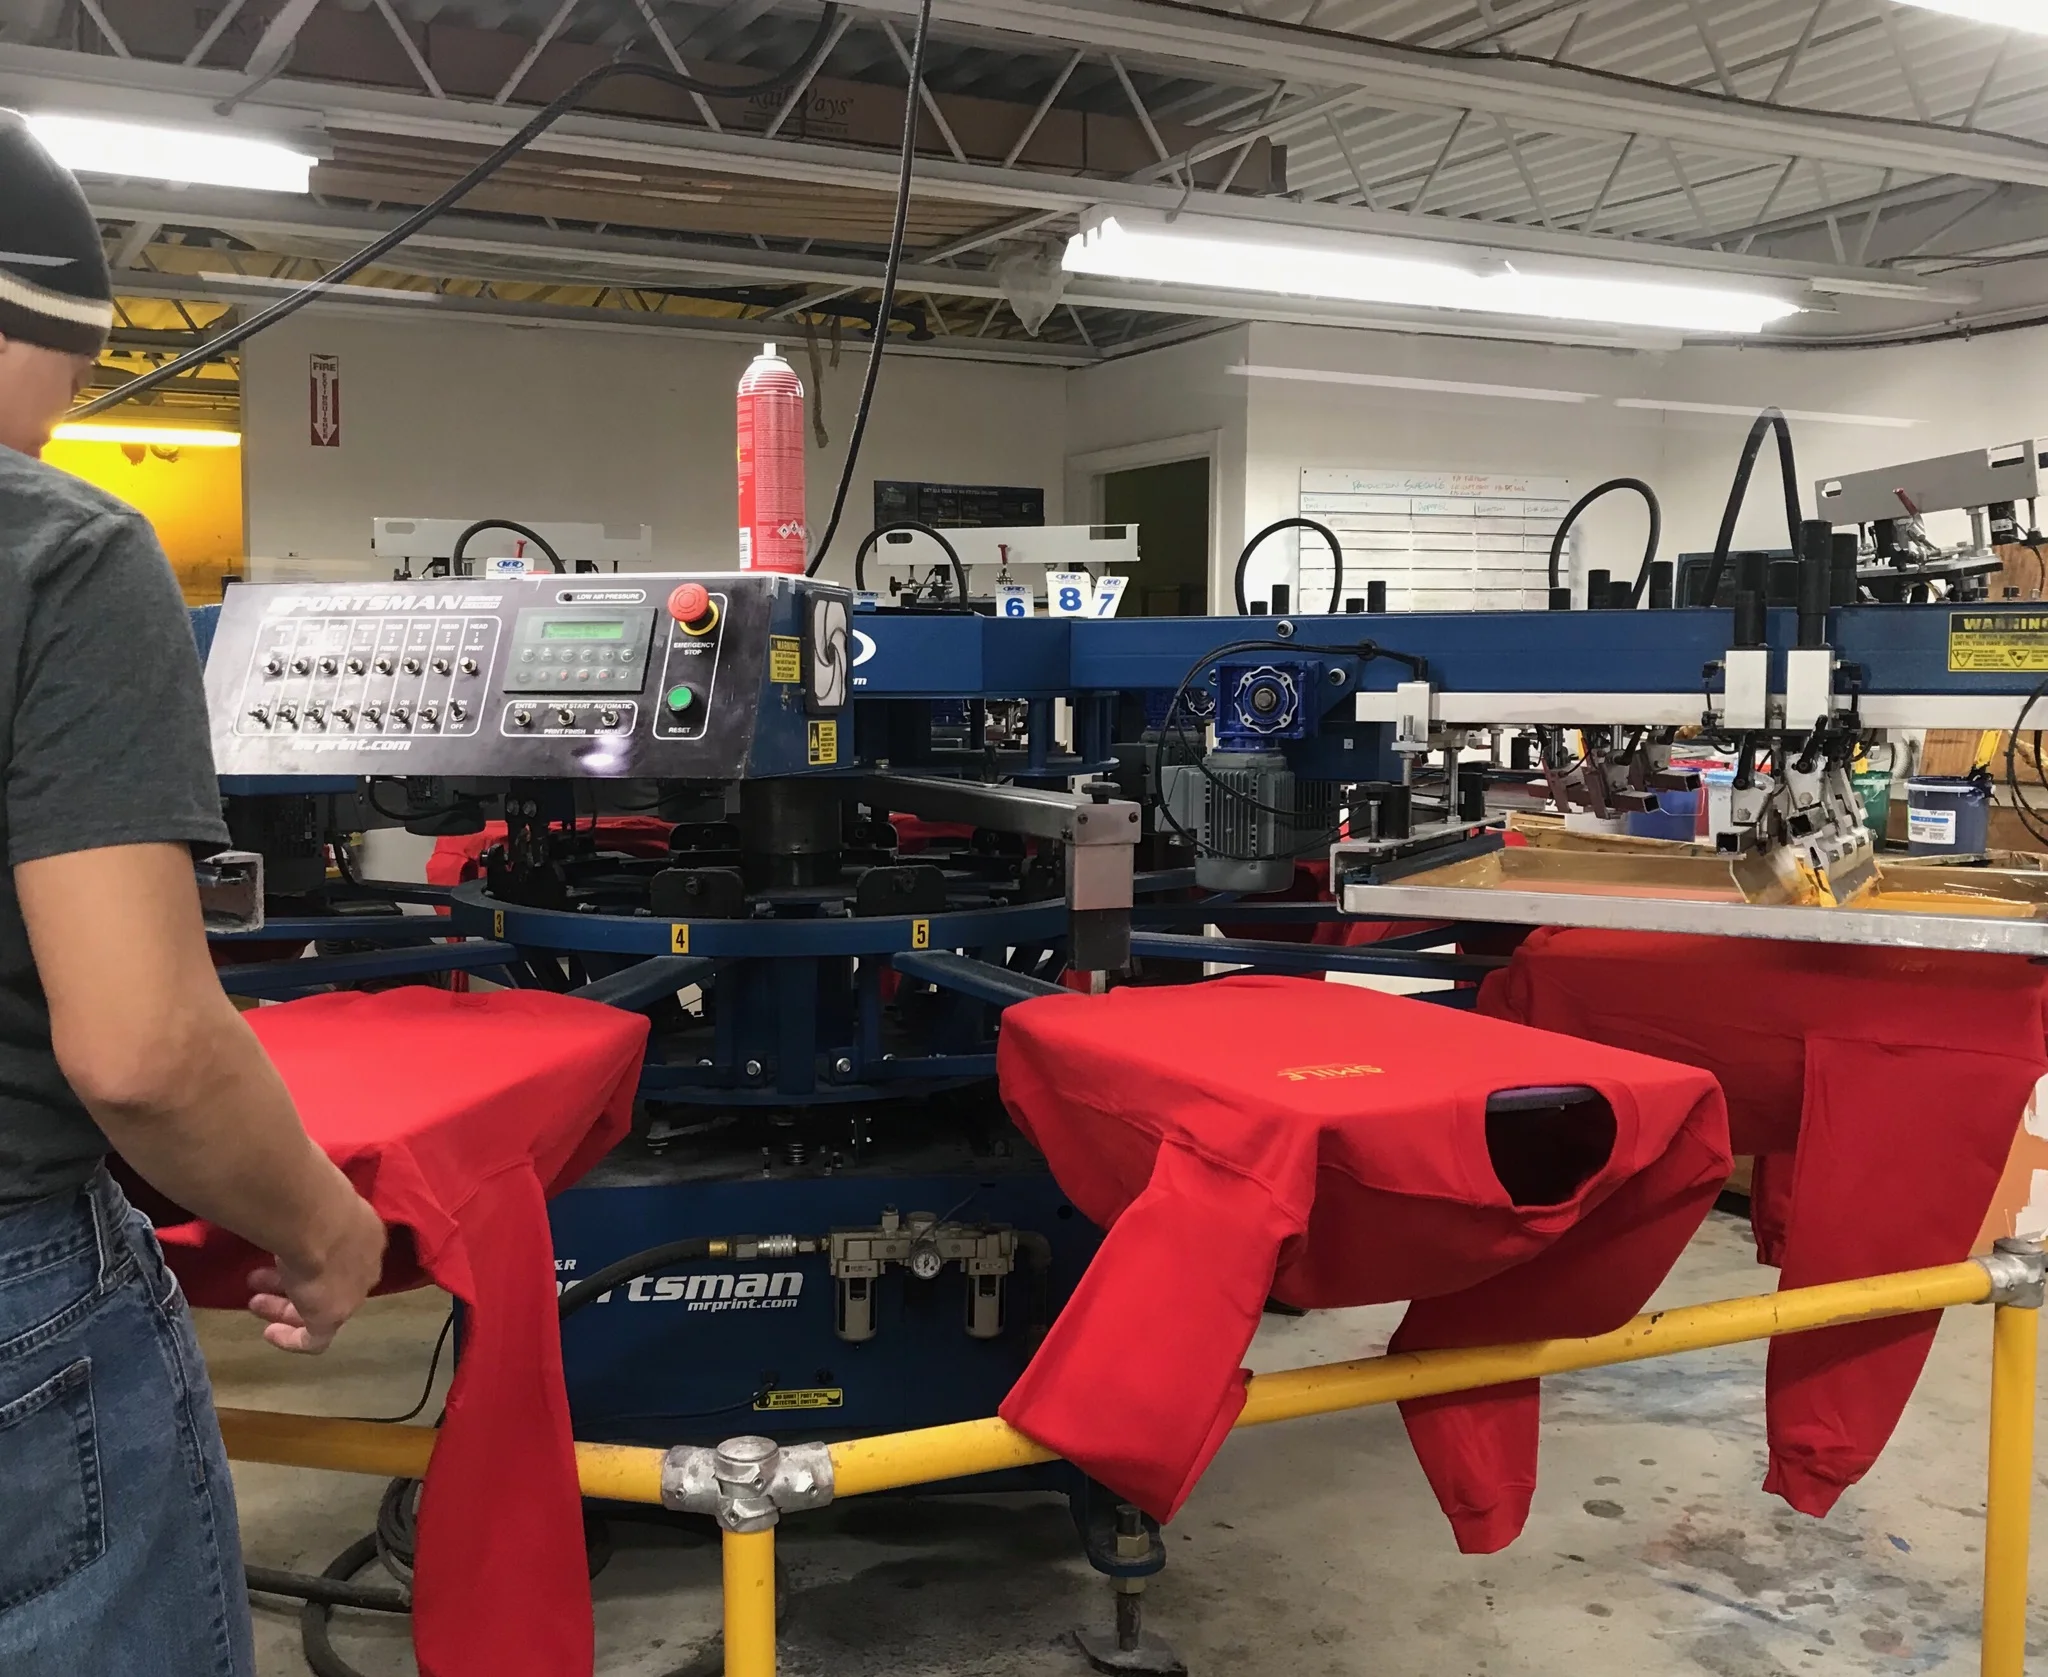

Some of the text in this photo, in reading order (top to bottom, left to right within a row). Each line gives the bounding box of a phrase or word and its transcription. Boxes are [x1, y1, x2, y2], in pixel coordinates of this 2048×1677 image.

[313, 362, 336, 371] FIRE
[1005, 597, 1026, 618] 6
[1059, 587, 1082, 611] 8
[1098, 593, 1115, 616] 7
[496, 913, 502, 934] 3
[916, 923, 926, 945] 5
[675, 928, 686, 949] 4
[687, 1298, 798, 1313] mrprint.com
